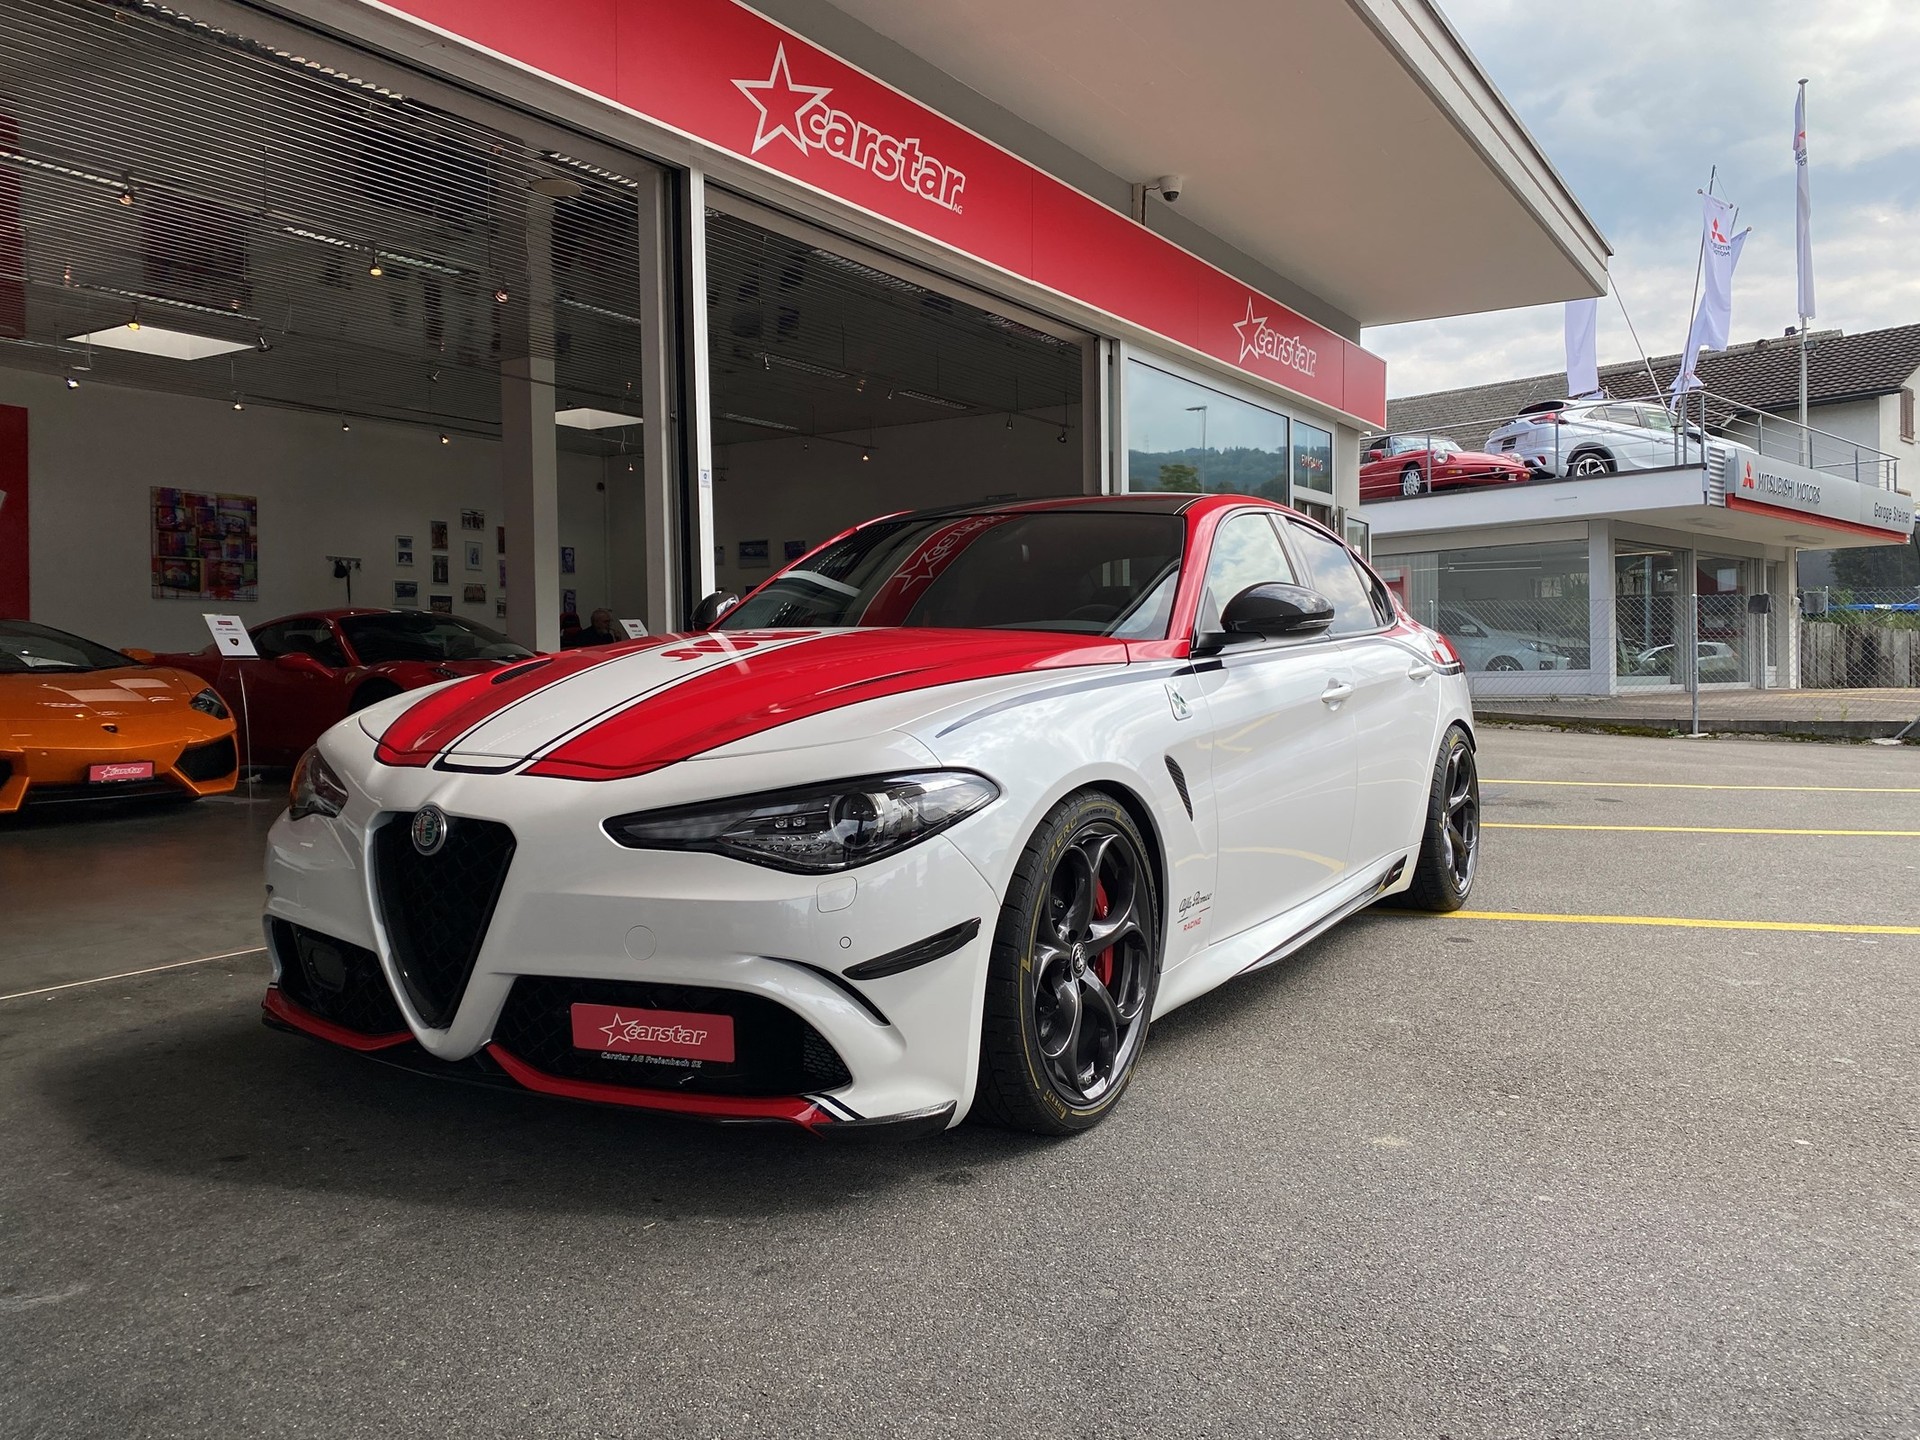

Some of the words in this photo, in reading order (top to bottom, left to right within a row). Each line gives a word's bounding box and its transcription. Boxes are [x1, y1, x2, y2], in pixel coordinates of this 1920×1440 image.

[795, 100, 966, 210] carstar
[952, 204, 963, 215] AG
[1254, 326, 1317, 376] carstar
[1758, 472, 1796, 499] MITSUBISHI
[1796, 482, 1820, 504] MOTORS
[1874, 502, 1892, 523] Garage
[1893, 506, 1910, 524] Steiner
[1050, 815, 1079, 862] ZERO
[625, 1024, 708, 1045] carstar
[601, 1052, 630, 1061] Carstar
[631, 1054, 645, 1063] AG
[645, 1055, 690, 1068] Freienbach
